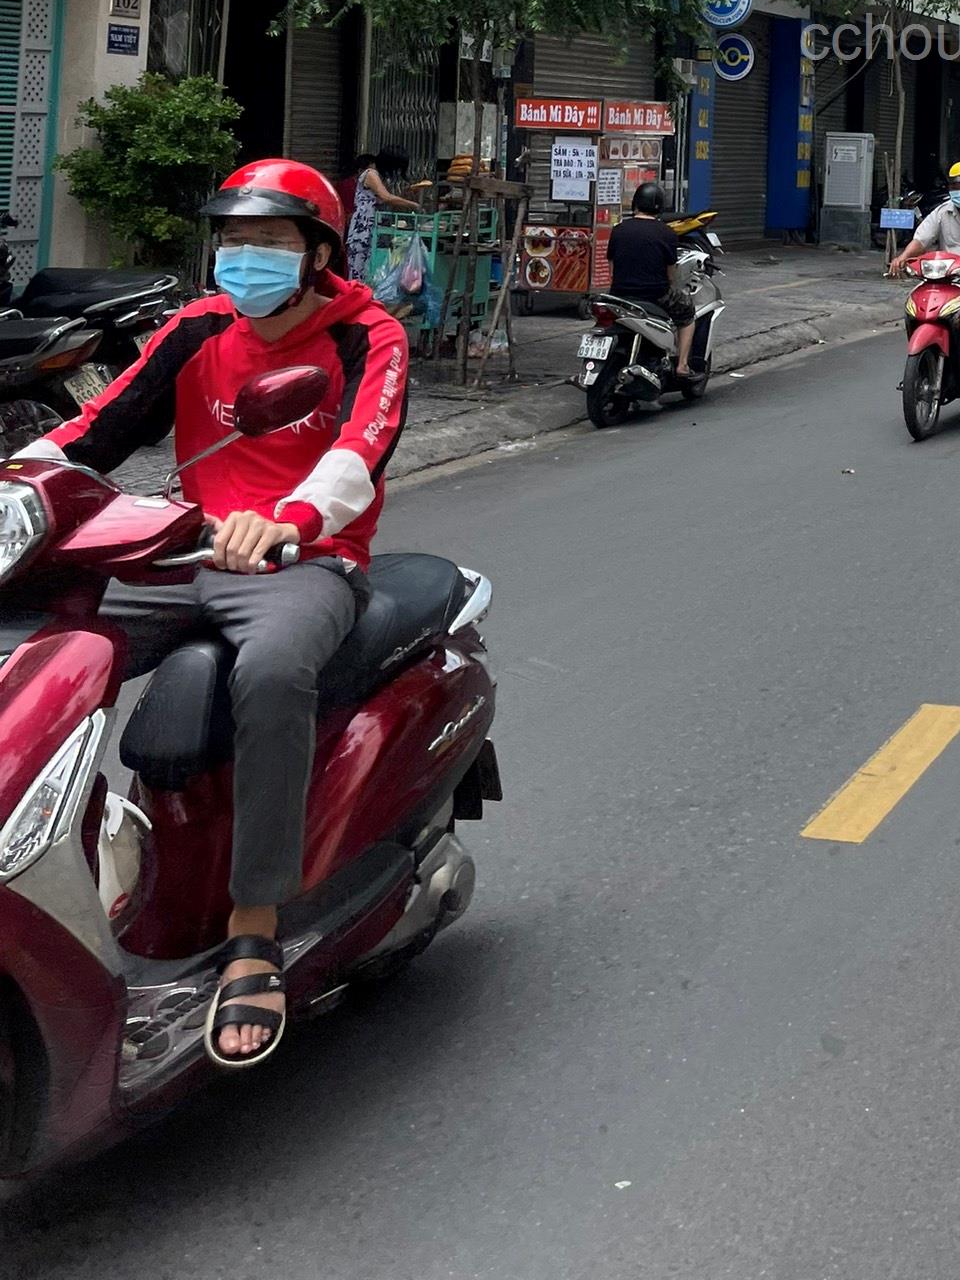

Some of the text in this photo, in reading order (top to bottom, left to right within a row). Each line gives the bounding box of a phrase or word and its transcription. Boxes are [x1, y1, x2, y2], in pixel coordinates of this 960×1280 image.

[520, 103, 597, 127] Bánh Mì Đây !!!
[608, 107, 631, 126] Bánh
[632, 107, 645, 126] Mì
[645, 108, 663, 130] Đây
